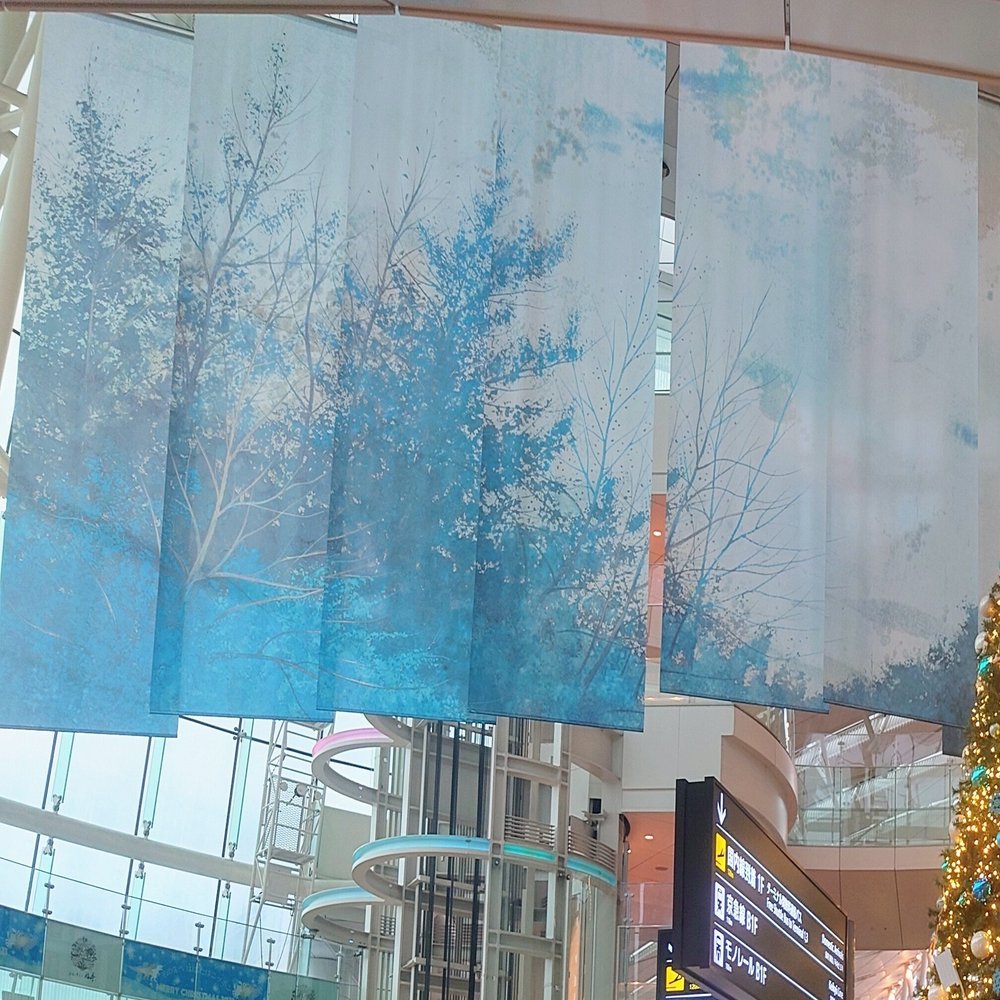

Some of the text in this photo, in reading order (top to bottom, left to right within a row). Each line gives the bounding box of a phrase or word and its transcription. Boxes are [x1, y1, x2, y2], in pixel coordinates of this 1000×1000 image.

[746, 911, 758, 935] B1F
[725, 939, 767, 985] モノレール B1F
